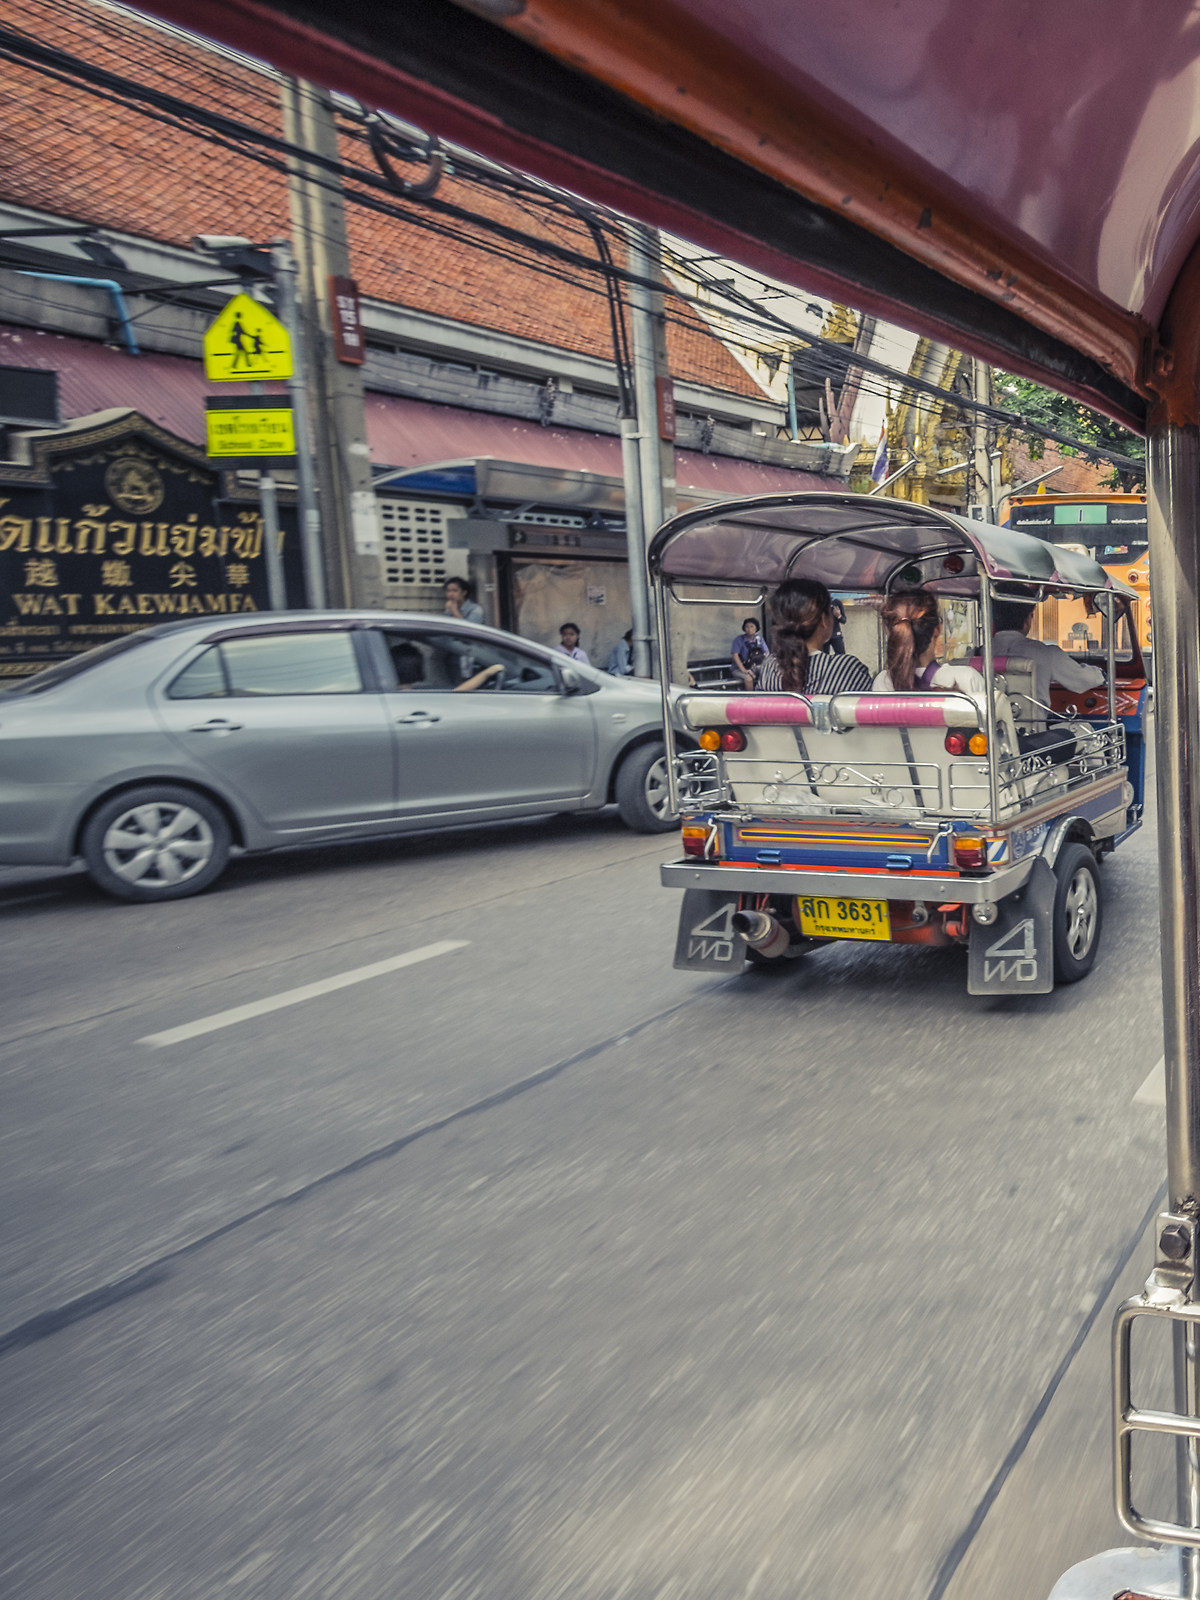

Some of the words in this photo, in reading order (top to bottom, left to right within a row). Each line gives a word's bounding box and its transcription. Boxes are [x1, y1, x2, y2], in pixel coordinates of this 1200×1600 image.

[12, 593, 82, 616] WAT
[93, 593, 259, 615] KAEWJAMFA
[690, 902, 735, 941] 4
[837, 901, 883, 923] 3631
[687, 938, 734, 962] WD
[984, 918, 1037, 959] 4
[983, 959, 1038, 982] WD
